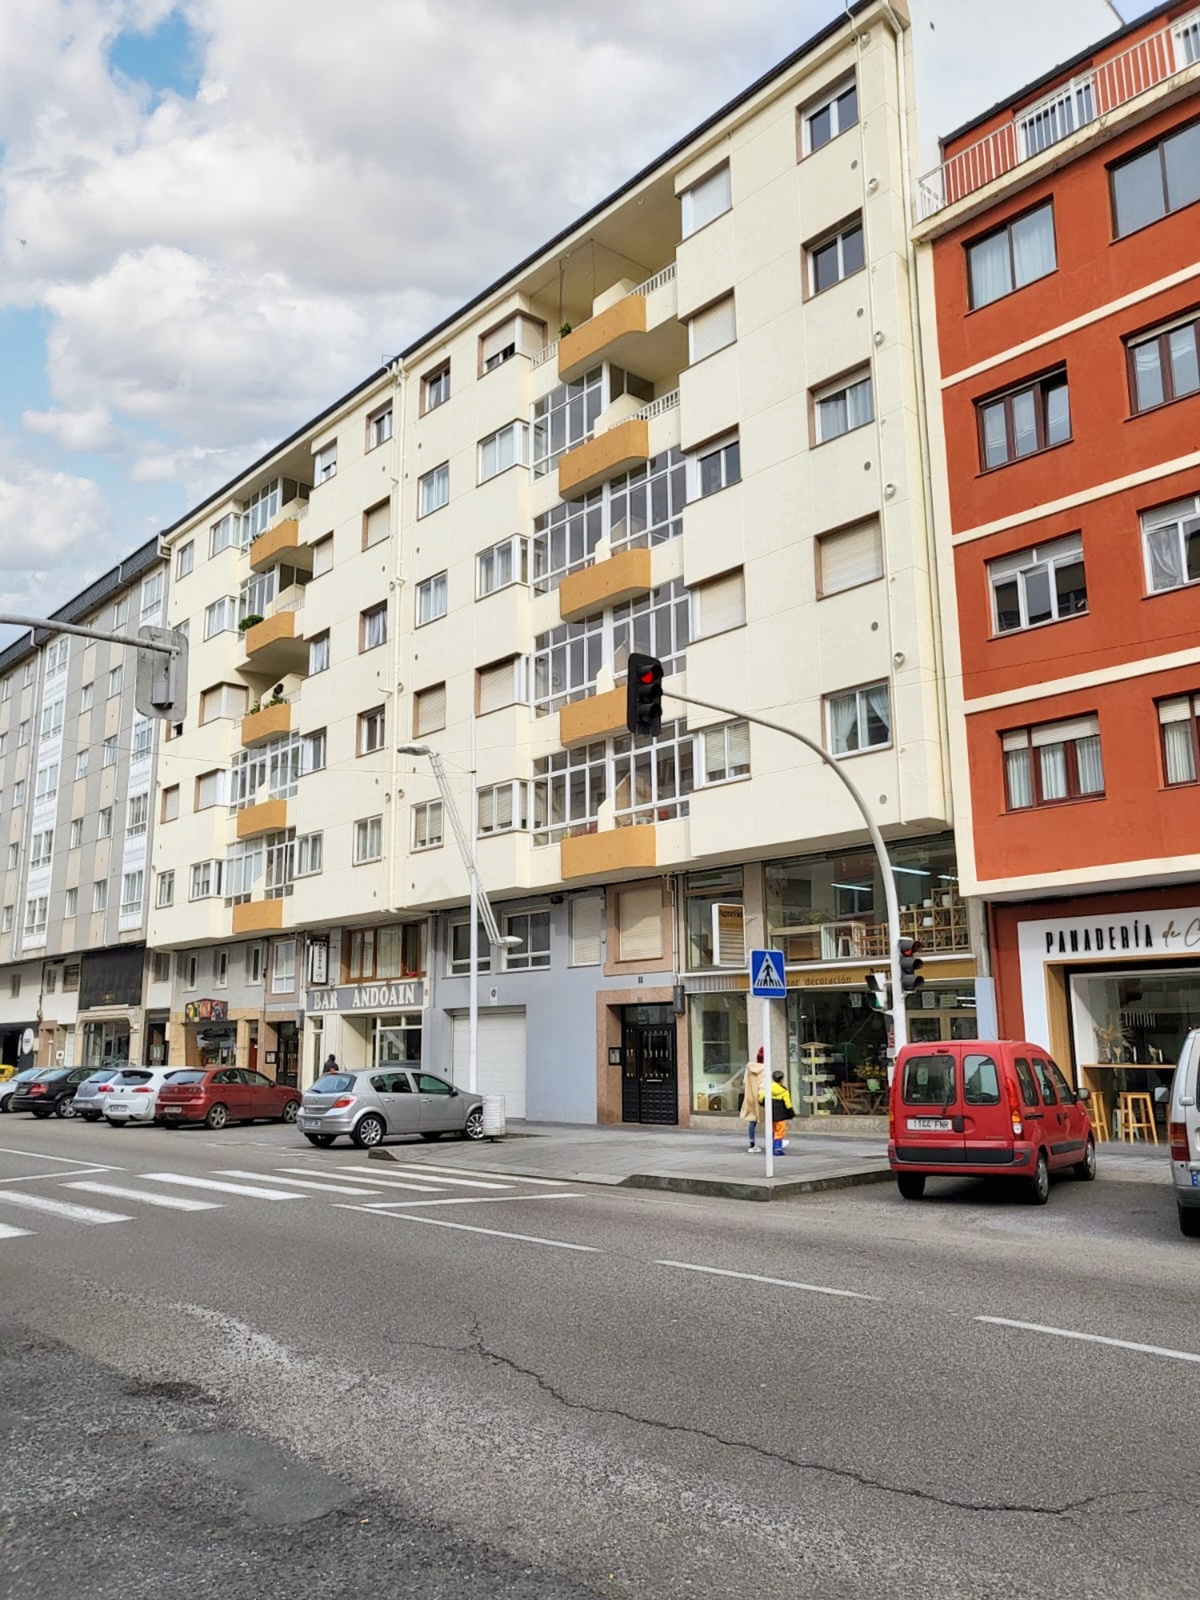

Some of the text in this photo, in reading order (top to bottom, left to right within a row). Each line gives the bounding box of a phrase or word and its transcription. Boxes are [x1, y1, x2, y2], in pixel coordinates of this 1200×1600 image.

[1045, 920, 1153, 953] PANADERÍA
[1162, 920, 1181, 947] de
[313, 984, 415, 1010] BAR ANDOAIN
